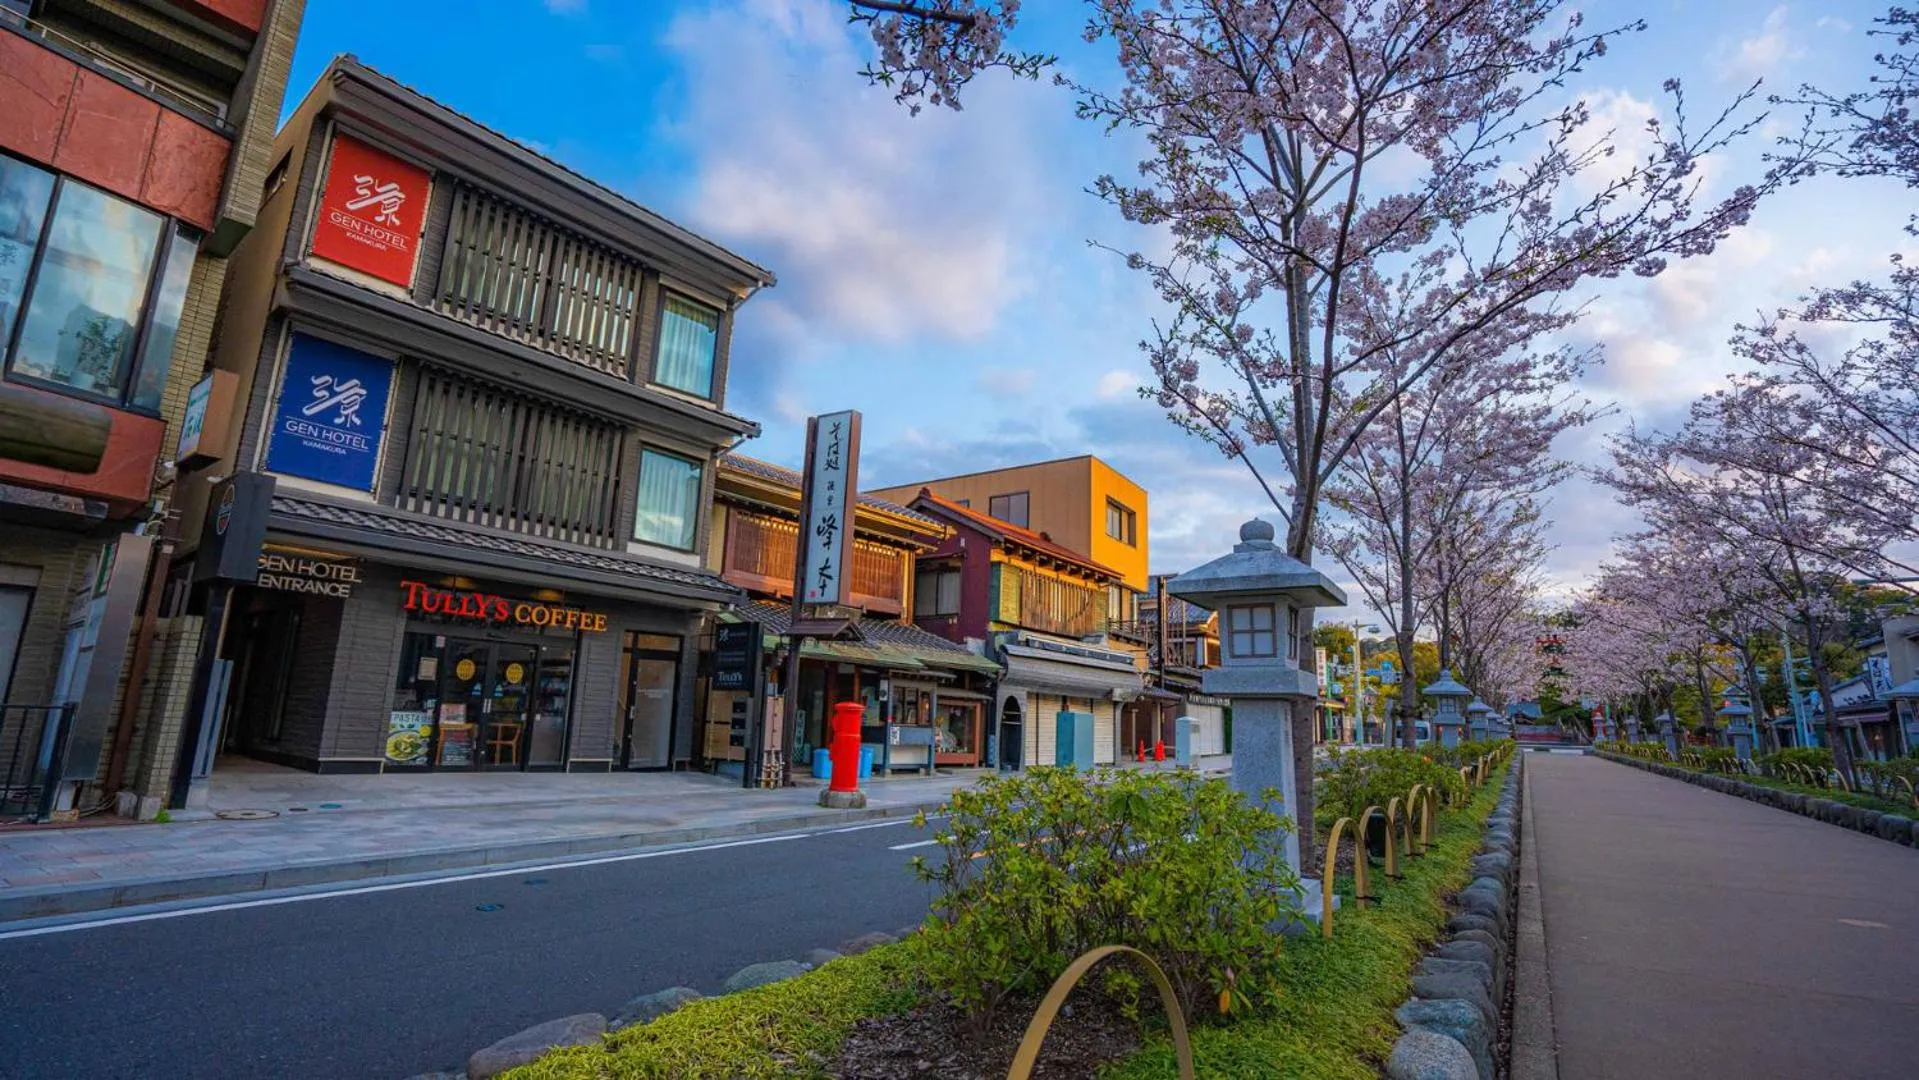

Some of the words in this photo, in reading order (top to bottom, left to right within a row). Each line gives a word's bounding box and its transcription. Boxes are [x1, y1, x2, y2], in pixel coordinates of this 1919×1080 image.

[330, 211, 361, 231] GEN
[363, 224, 408, 249] HOTEL
[286, 420, 319, 437] GEN
[321, 429, 369, 450] HOTEL
[258, 573, 350, 598] ENTRANCE
[299, 559, 362, 583] HOTEL
[515, 603, 608, 632] COFFEE
